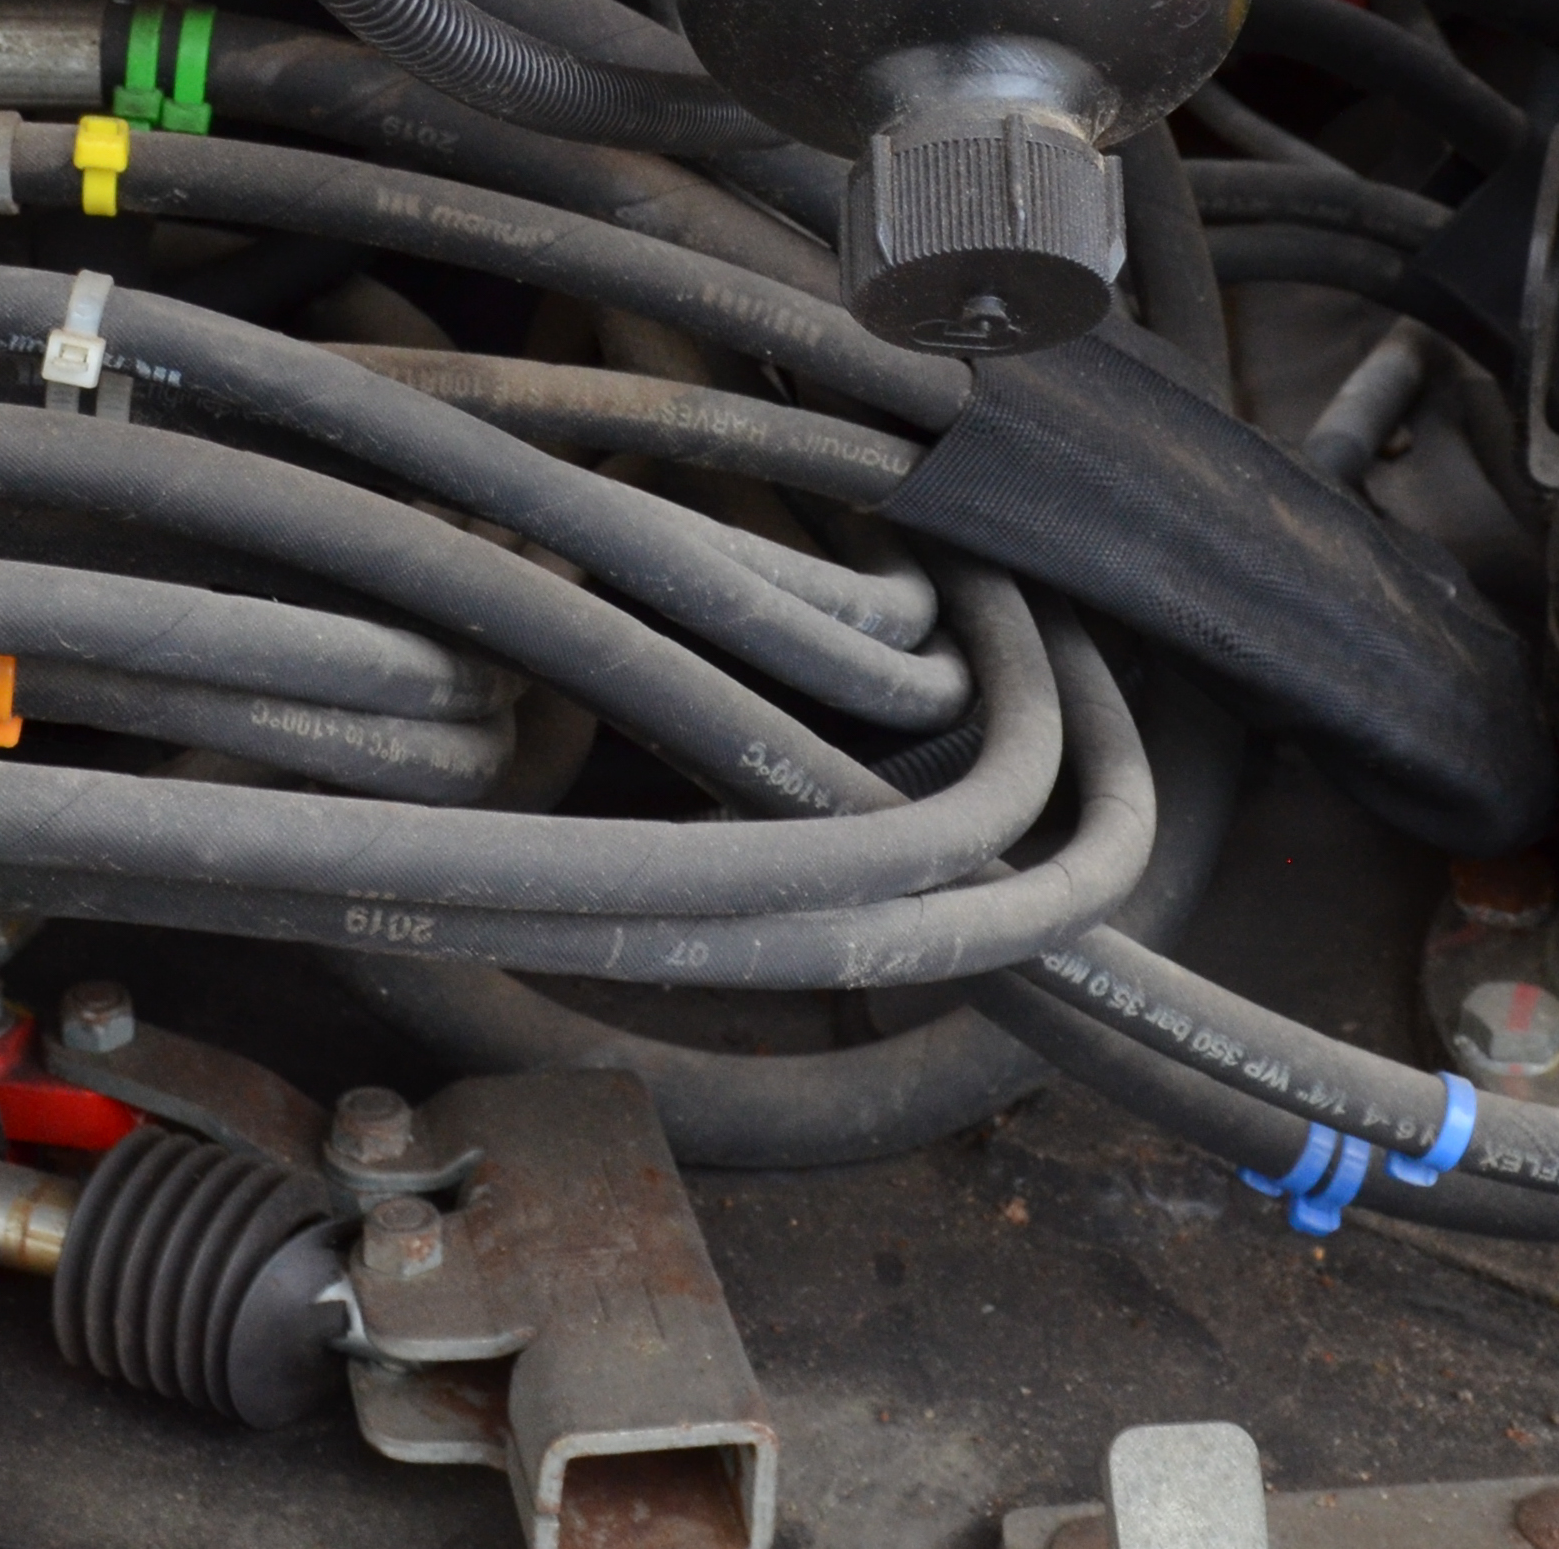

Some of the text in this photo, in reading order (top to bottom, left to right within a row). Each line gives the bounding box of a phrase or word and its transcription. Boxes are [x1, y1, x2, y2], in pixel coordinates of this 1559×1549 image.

[345, 903, 435, 945] 2019
[1144, 1005, 1194, 1043] bar
[1191, 1026, 1244, 1068] 350
[1243, 1061, 1292, 1094] WP
